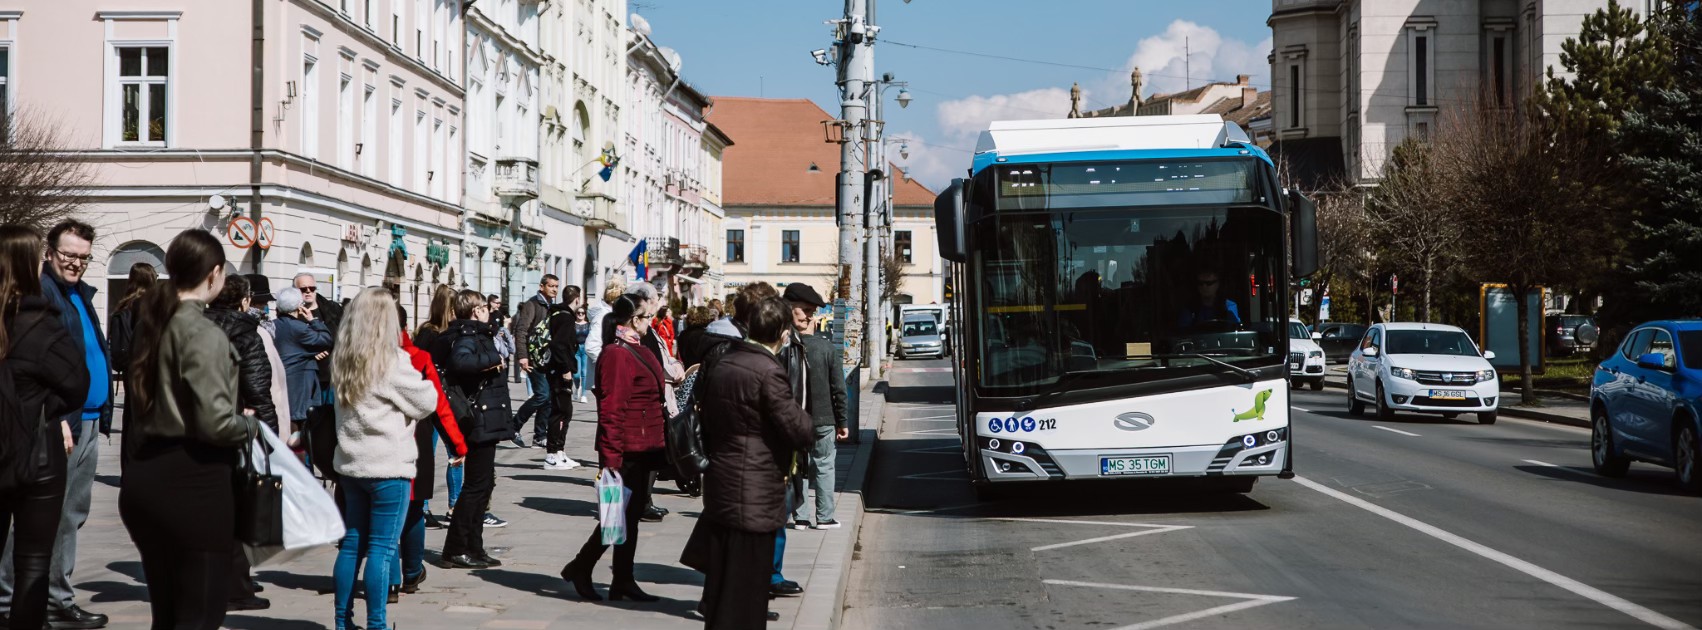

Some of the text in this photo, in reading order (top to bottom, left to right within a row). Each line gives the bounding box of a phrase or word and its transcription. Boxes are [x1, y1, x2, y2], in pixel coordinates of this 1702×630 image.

[1038, 418, 1057, 431] 212
[1109, 459, 1125, 471] MS
[1128, 459, 1142, 470] 35
[1144, 458, 1166, 470] TGM
